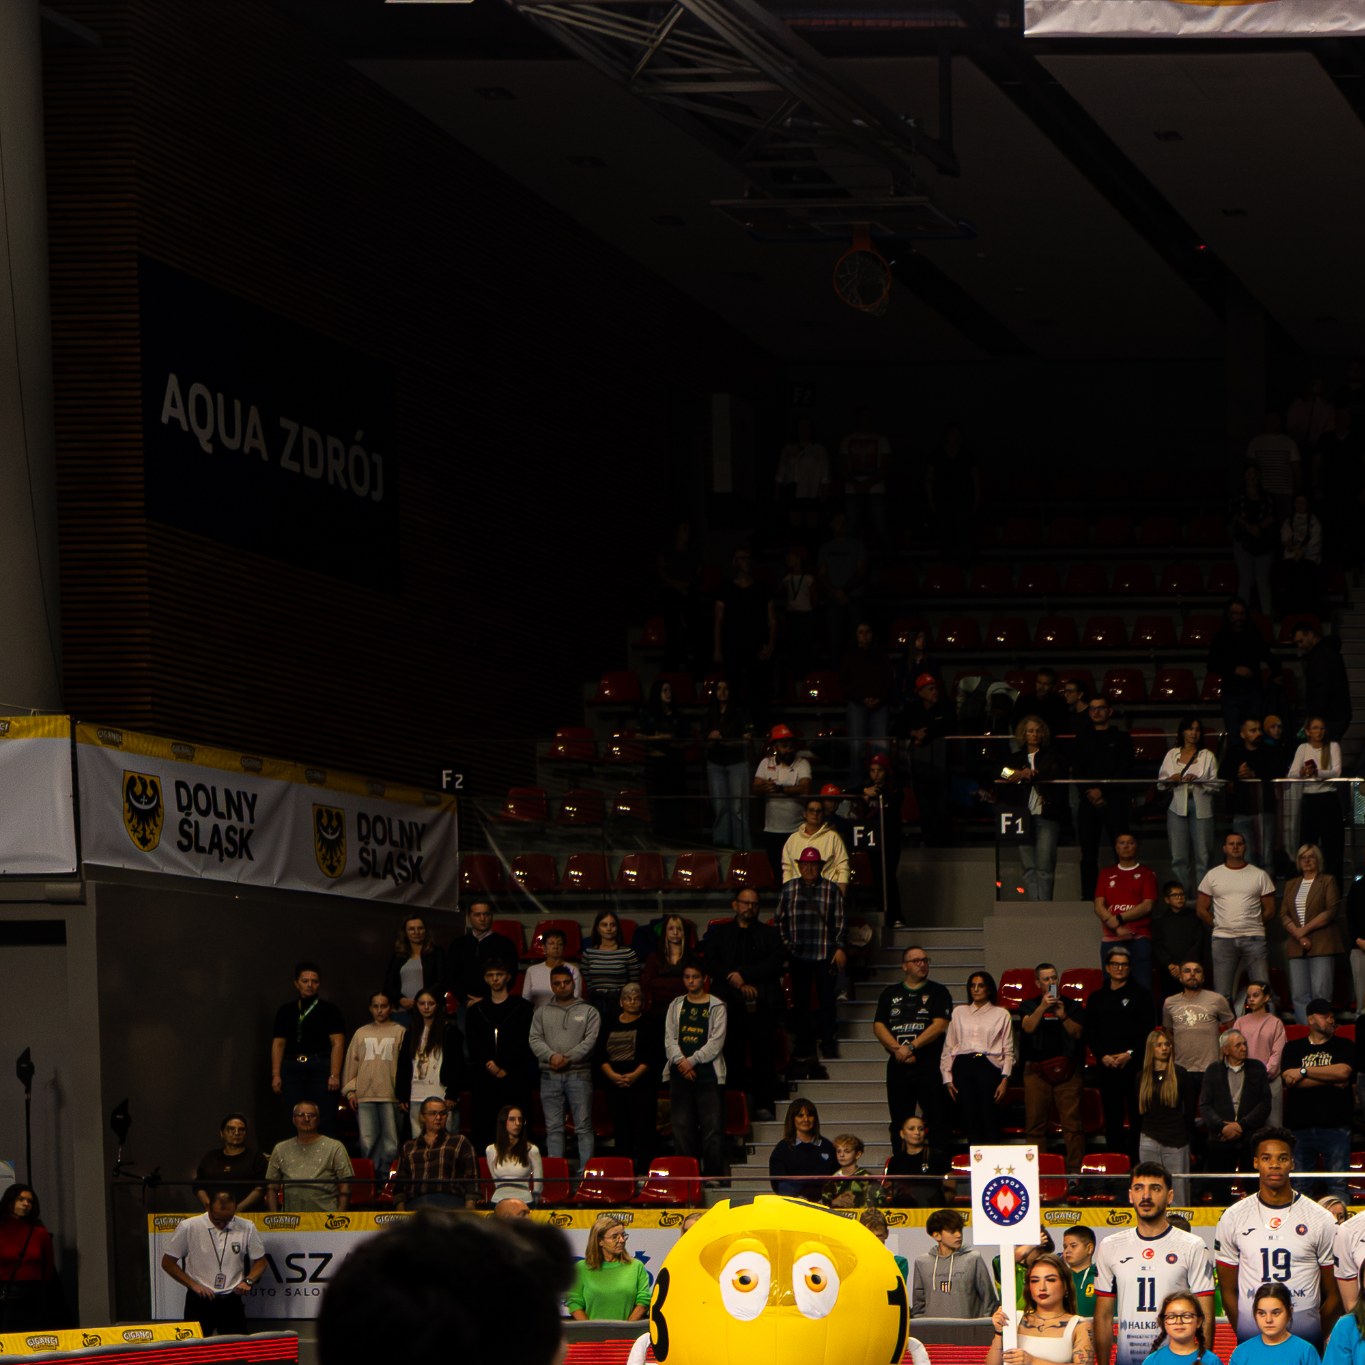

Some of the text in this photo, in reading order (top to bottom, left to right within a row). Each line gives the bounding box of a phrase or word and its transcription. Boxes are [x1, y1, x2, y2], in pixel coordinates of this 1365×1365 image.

[161, 371, 384, 503] AQUA ZDRÓJ
[442, 769, 464, 790] F2
[175, 779, 257, 824] DOLNY
[177, 811, 254, 861] ŚLĄSK
[357, 813, 426, 852] DOLNY
[854, 826, 876, 847] F1
[1001, 813, 1024, 834] F1
[359, 841, 425, 885] ŚLĄSK
[364, 1037, 396, 1062] M
[265, 1215, 300, 1226] GIGANCI
[1045, 1211, 1080, 1222] GIGANCI
[1260, 1247, 1291, 1283] 19
[1136, 1277, 1157, 1312] 11
